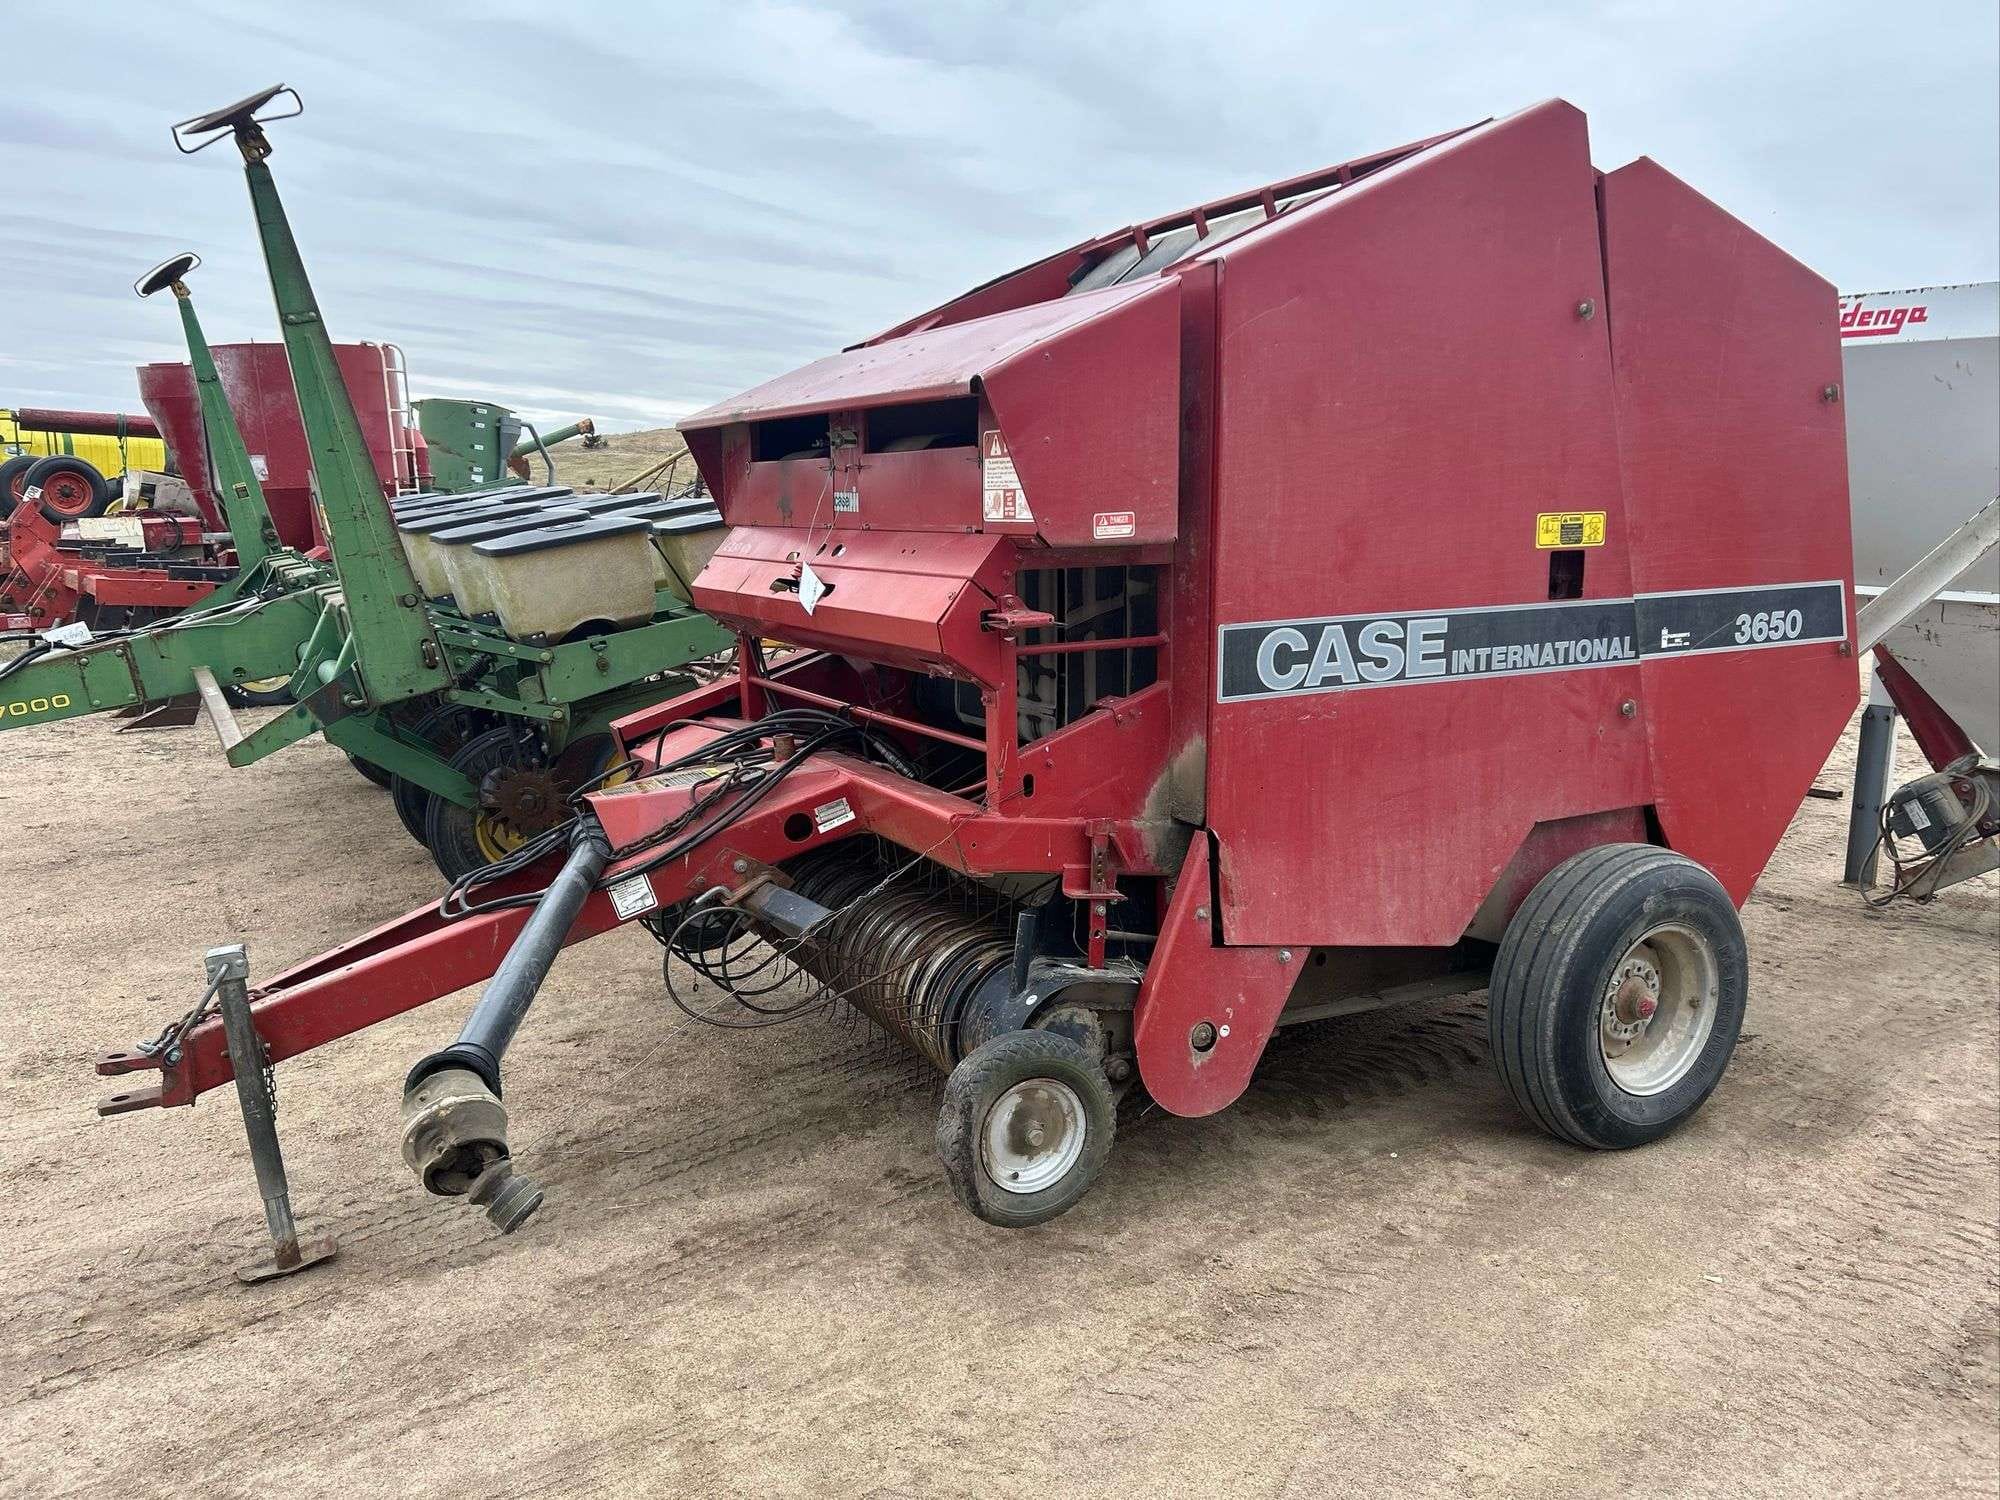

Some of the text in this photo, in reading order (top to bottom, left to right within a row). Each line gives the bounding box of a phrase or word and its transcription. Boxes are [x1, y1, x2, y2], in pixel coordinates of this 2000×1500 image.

[1839, 302, 1928, 337] denga
[1735, 609, 1803, 644] 3650
[1257, 617, 1636, 691] CASE INTERNATIONAL
